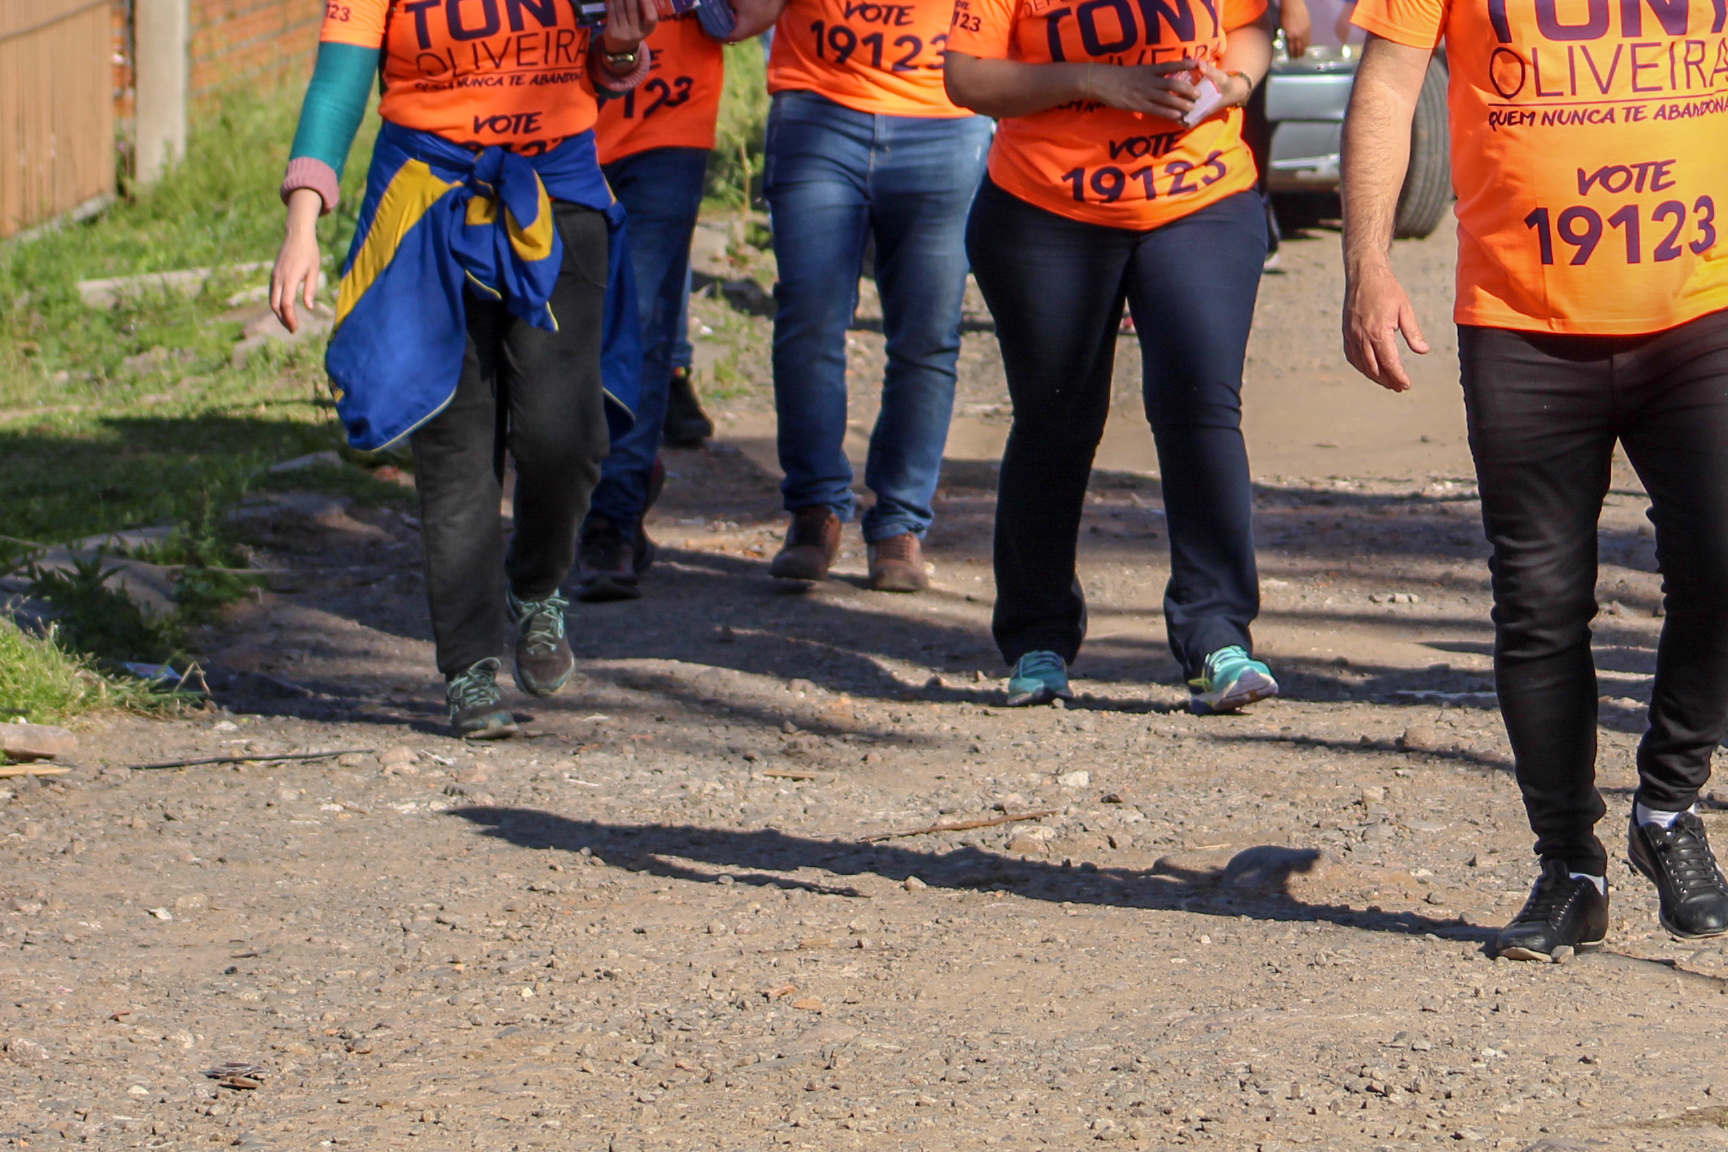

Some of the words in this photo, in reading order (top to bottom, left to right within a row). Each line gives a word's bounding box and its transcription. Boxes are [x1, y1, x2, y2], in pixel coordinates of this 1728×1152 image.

[844, 0, 916, 27] VOTE
[416, 29, 590, 78] OLIVEIRA
[509, 75, 525, 85] TE
[473, 111, 543, 135] VOTE
[1489, 110, 1536, 131] QUEM
[1541, 108, 1615, 126] NUNCA
[1623, 105, 1647, 122] TE
[1109, 130, 1187, 159] VOTE
[1577, 159, 1677, 196] VOTE
[1523, 195, 1717, 266] 19123
